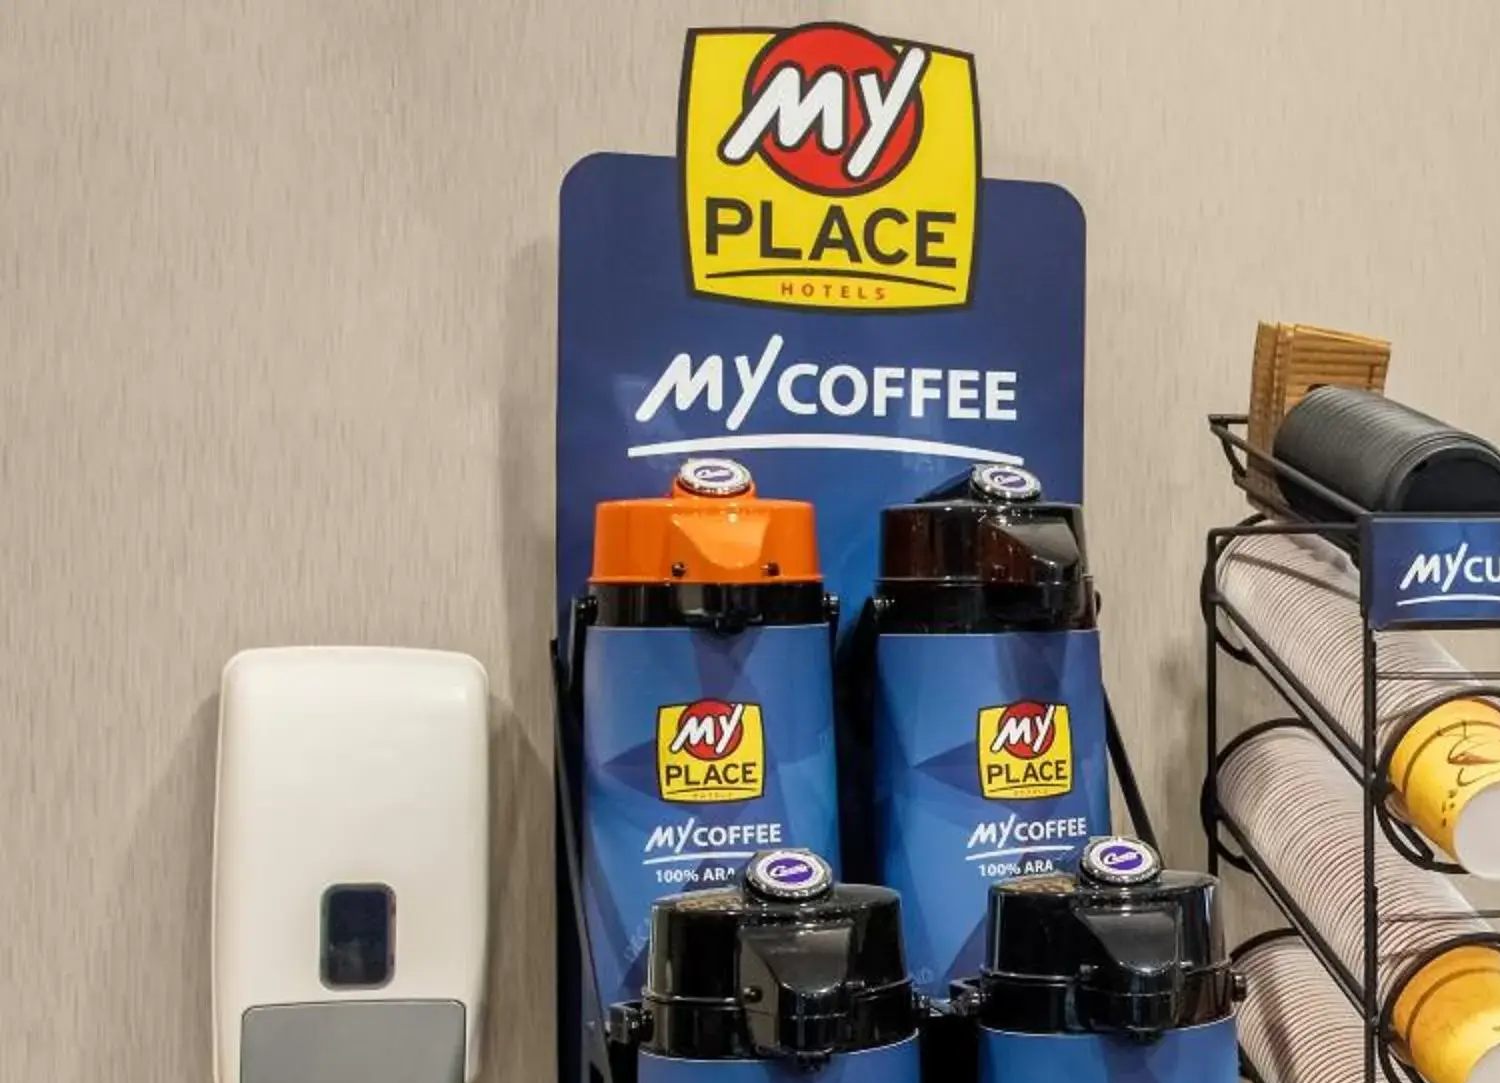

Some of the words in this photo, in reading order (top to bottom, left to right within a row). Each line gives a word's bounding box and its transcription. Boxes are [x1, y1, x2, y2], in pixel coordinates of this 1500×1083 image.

[705, 197, 957, 269] PLACE
[780, 282, 887, 301] HOTELS
[665, 762, 758, 787] PLACE
[987, 760, 1068, 785] PLACE
[655, 867, 699, 883] 100%
[977, 862, 1021, 877] 100%
